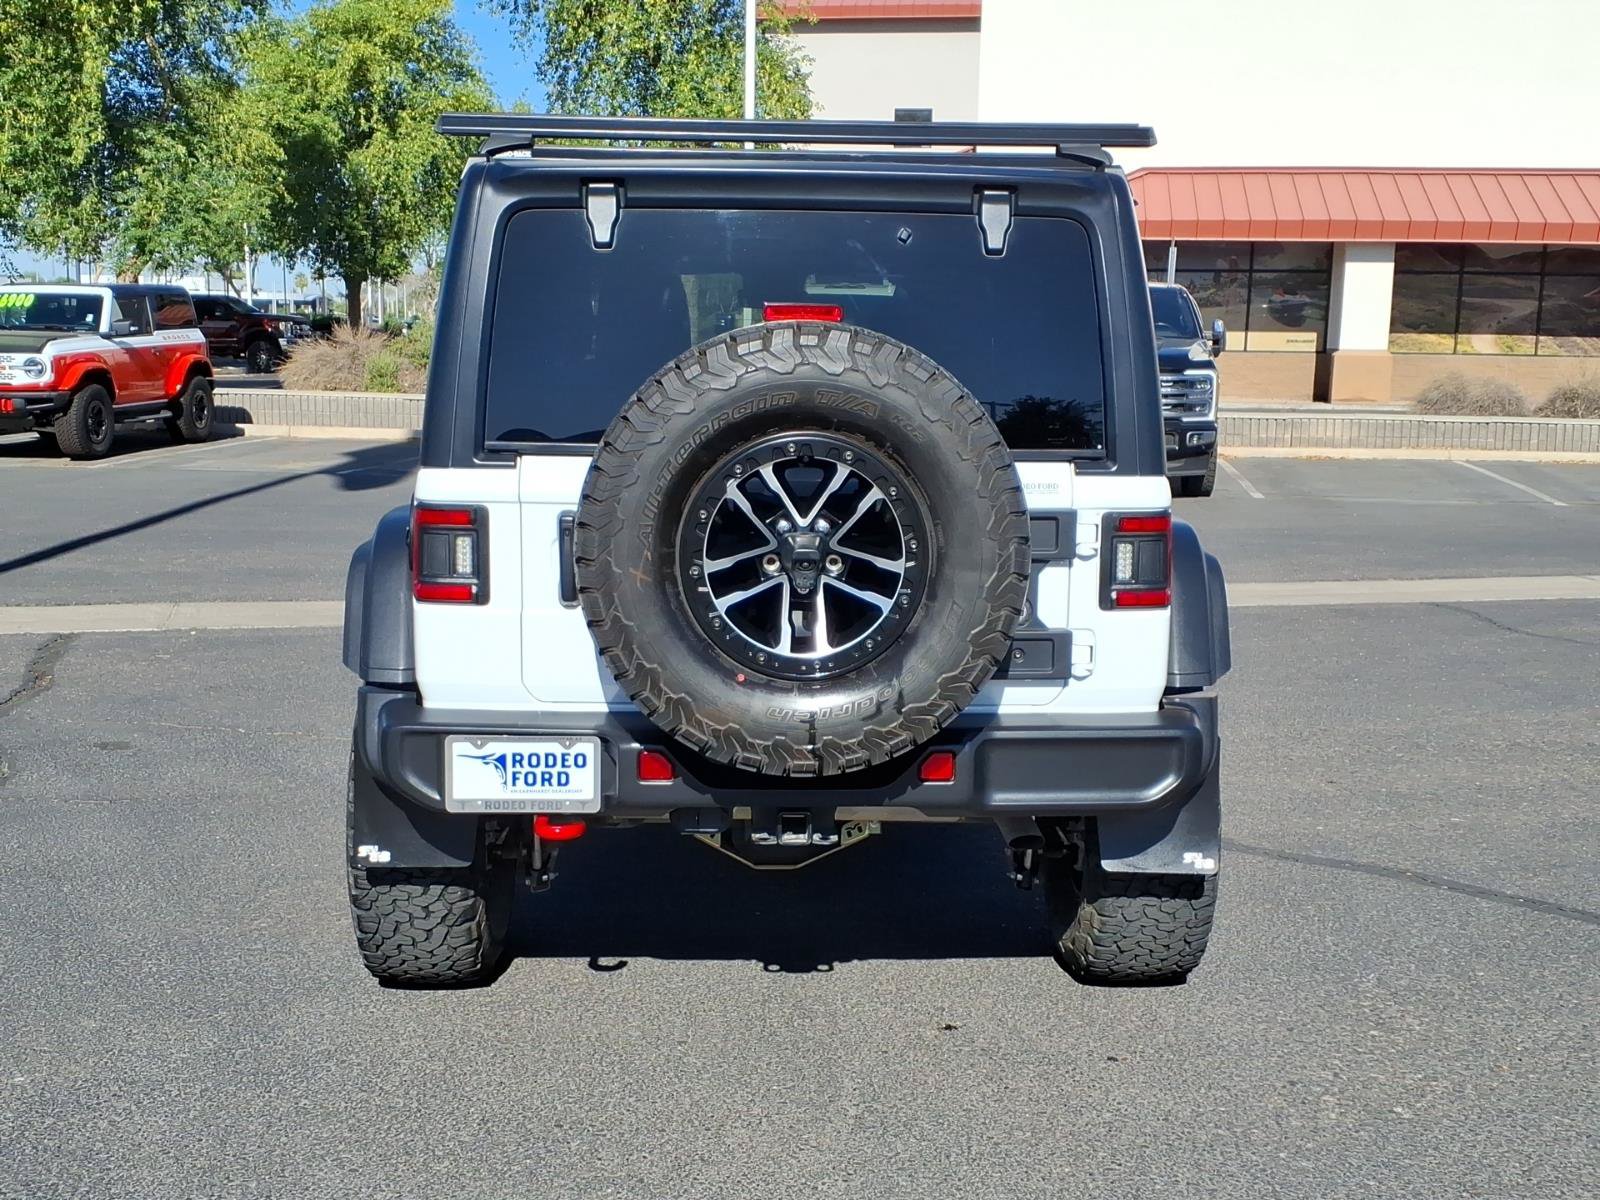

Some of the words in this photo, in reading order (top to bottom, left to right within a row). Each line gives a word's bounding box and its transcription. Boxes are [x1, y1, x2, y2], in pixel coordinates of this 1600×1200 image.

[638, 391, 798, 546] All-Terrain
[816, 389, 879, 419] T/A
[511, 752, 587, 769] RODEO
[511, 771, 570, 787] FORD
[484, 801, 526, 810] RODEO
[531, 801, 563, 810] FORD
